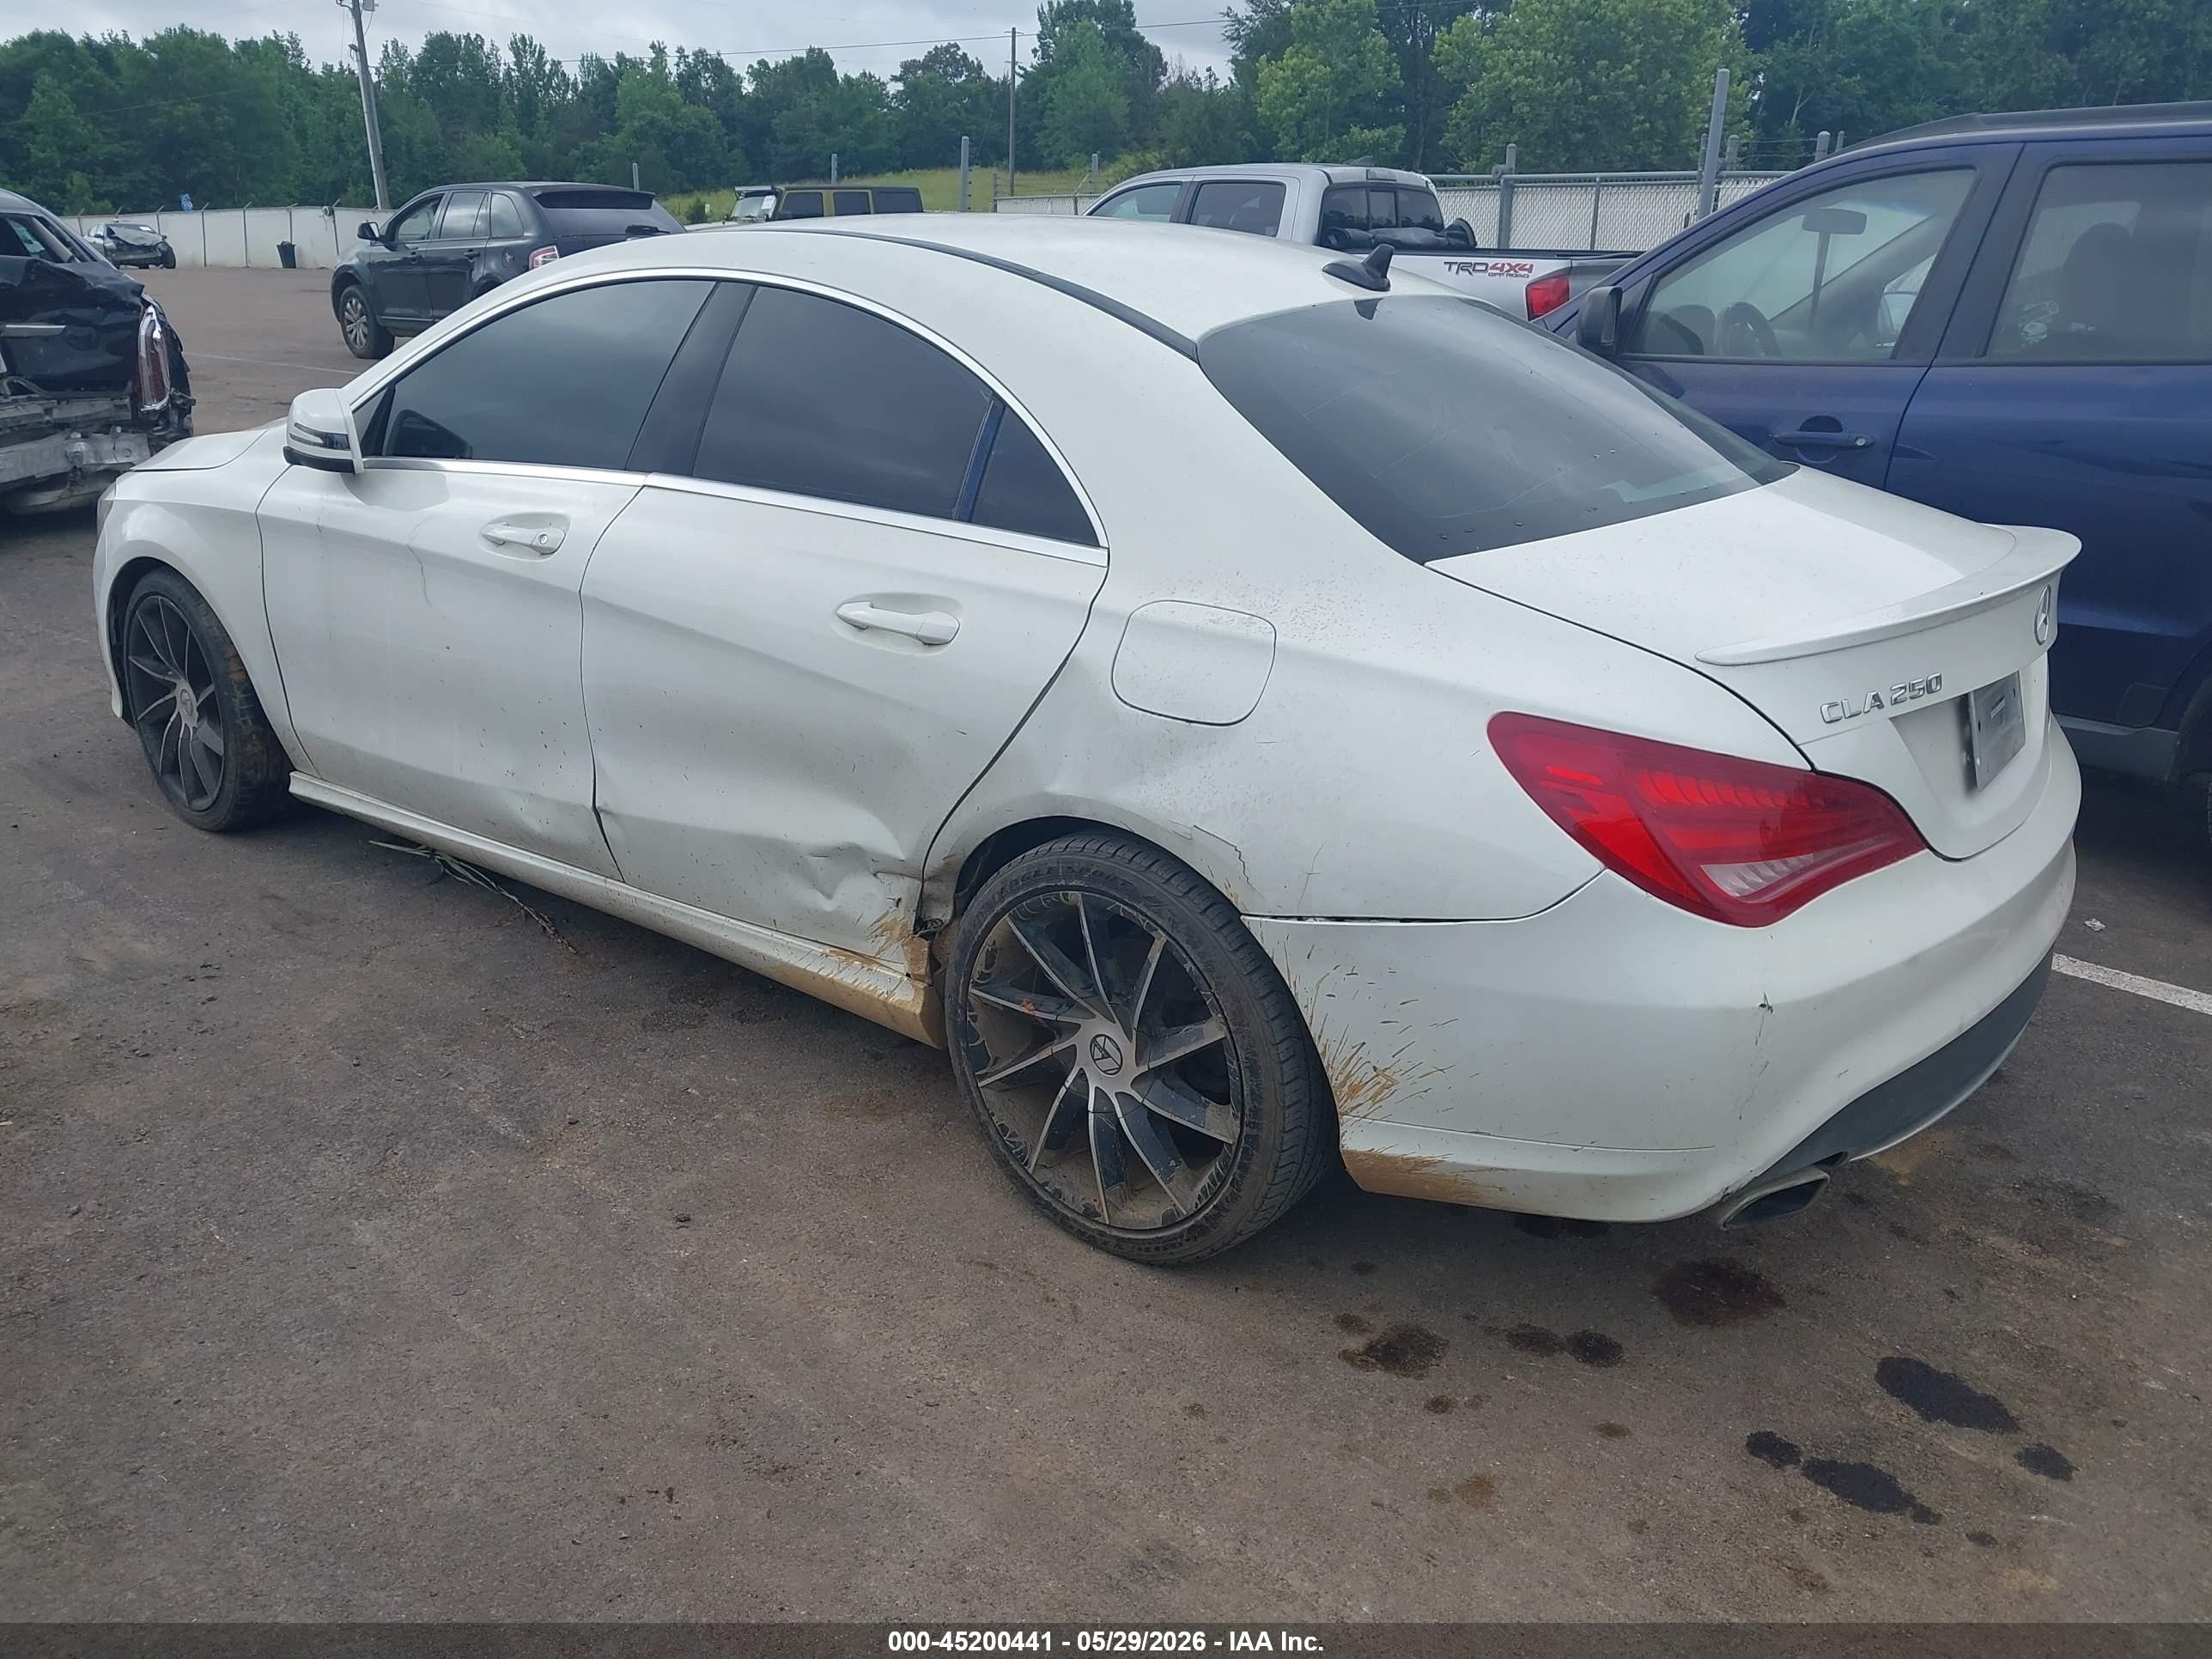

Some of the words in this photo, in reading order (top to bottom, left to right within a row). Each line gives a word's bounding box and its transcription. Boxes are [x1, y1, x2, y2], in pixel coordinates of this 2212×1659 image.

[1443, 261, 1489, 276] TRD
[1820, 690, 1885, 724] CLA
[1890, 672, 1942, 706] 250
